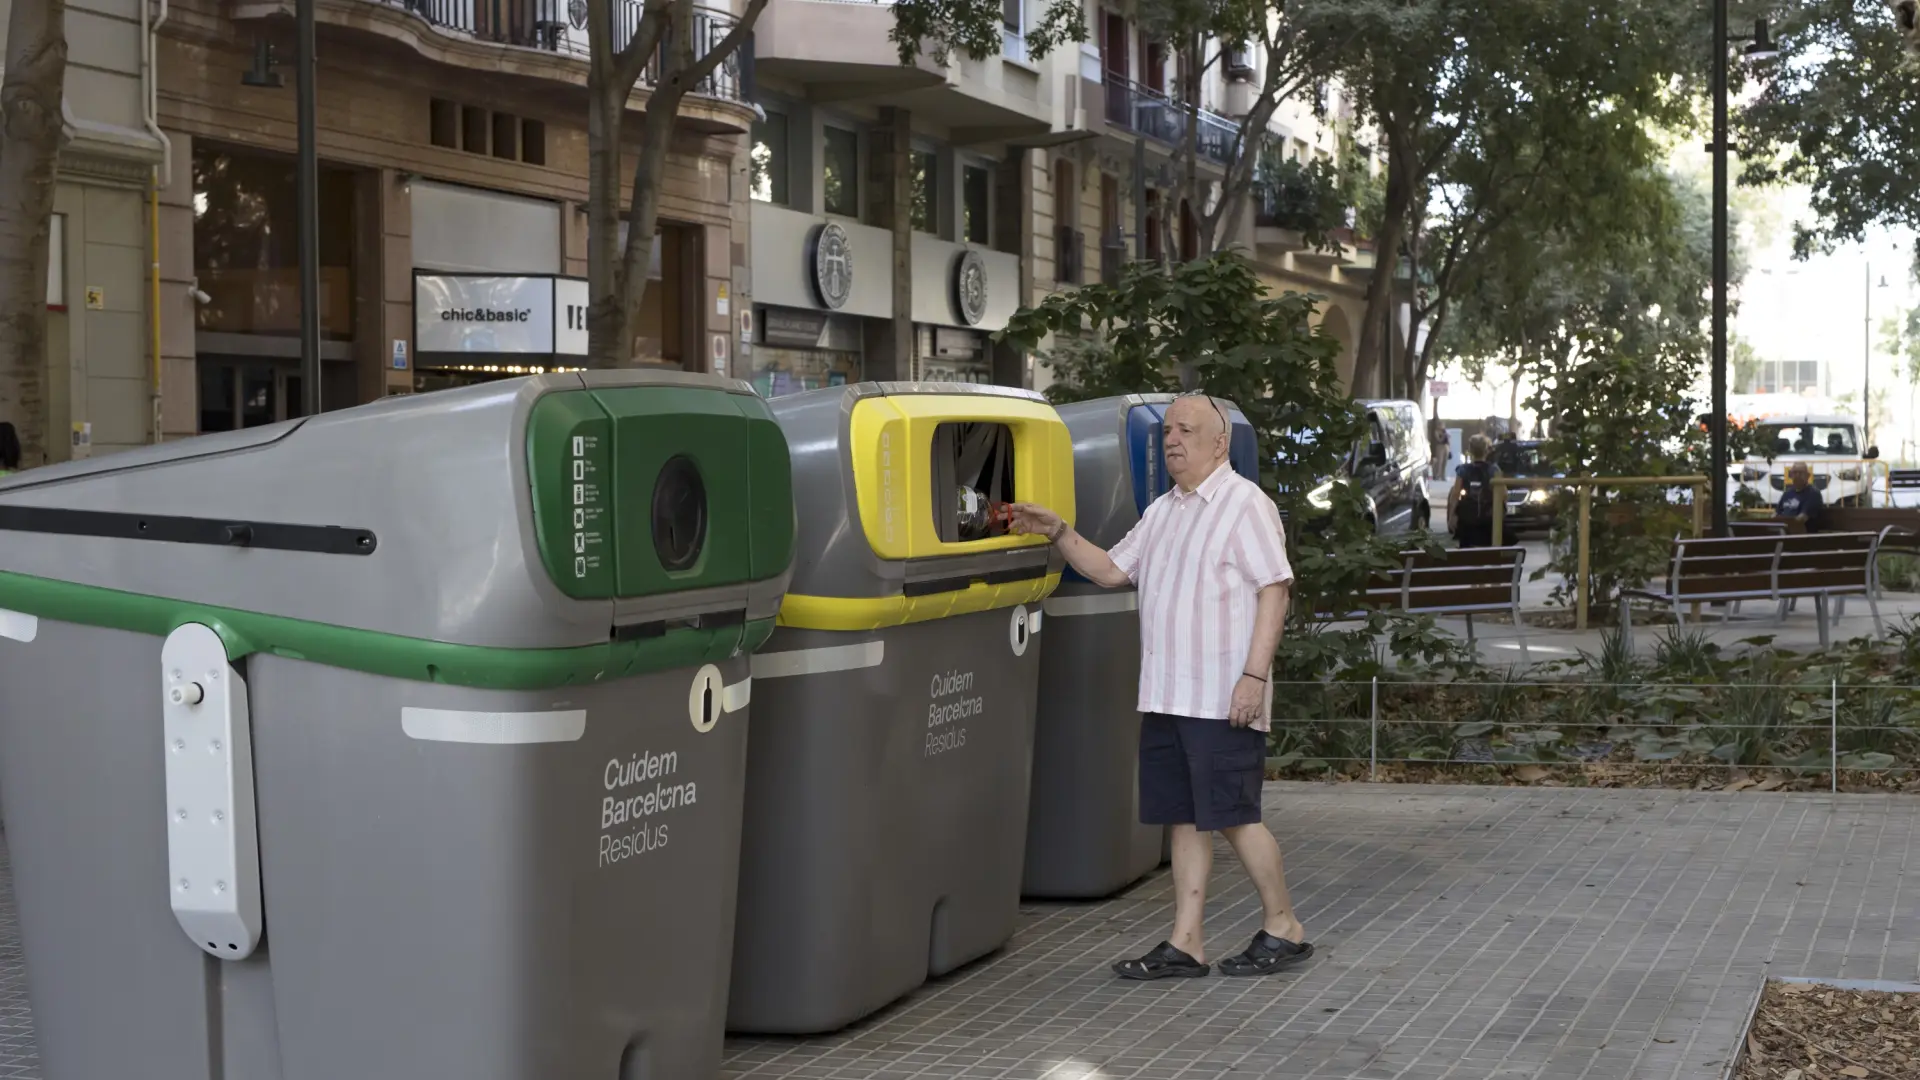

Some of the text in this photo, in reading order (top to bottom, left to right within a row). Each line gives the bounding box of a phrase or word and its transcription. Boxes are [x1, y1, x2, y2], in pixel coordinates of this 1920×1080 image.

[930, 669, 974, 699] Cuidem
[927, 695, 983, 729] Barcelona
[924, 725, 967, 758] Residus
[603, 750, 678, 791] Cuidem
[601, 782, 697, 830] Barcelona
[599, 821, 669, 868] Residus
